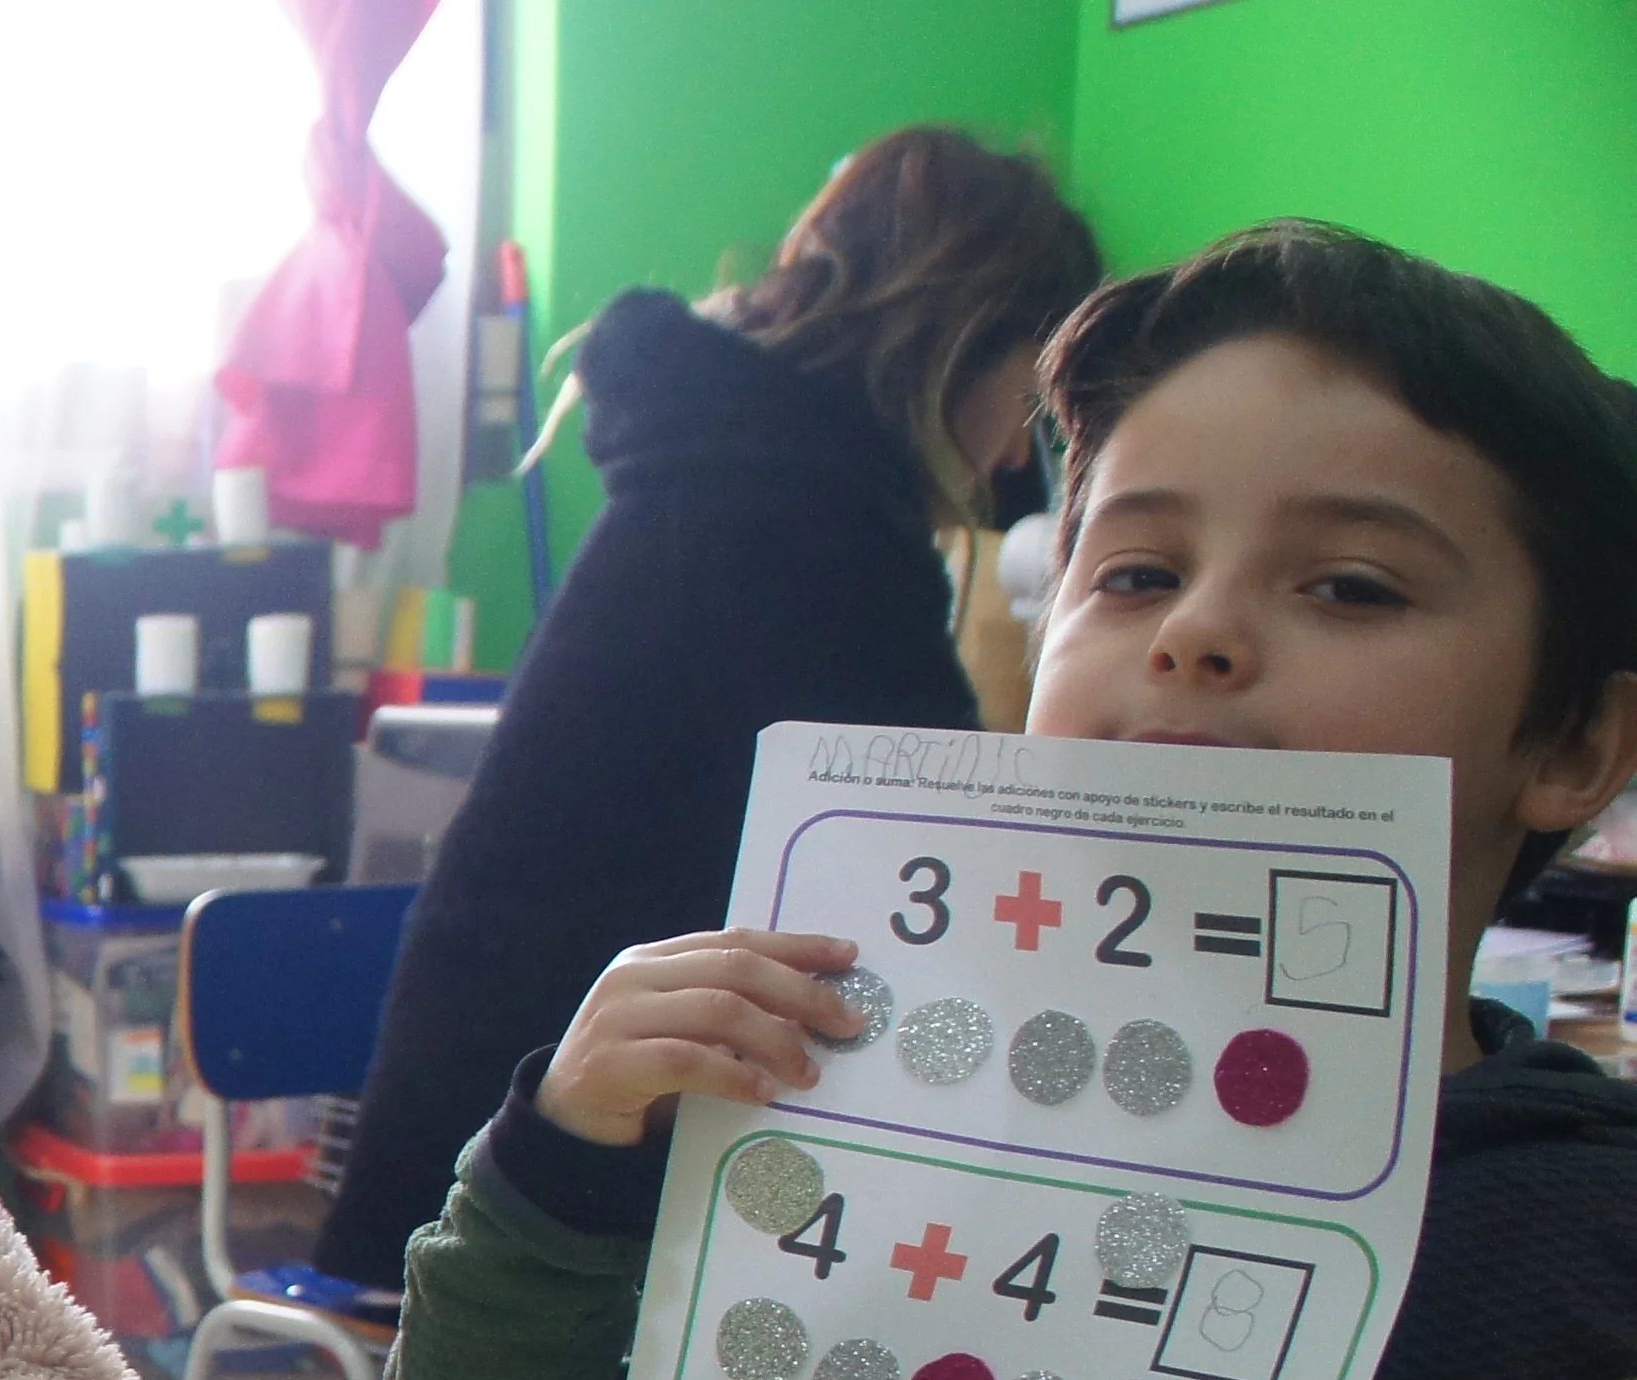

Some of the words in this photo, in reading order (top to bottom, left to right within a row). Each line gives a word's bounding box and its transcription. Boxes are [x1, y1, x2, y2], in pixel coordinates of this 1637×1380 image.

[809, 770, 860, 786] Adición
[863, 777, 871, 786] o
[875, 777, 914, 788] suma:
[917, 777, 974, 792] Resuelve
[977, 782, 994, 794] las
[997, 784, 1055, 798] adiciones
[1058, 790, 1079, 800] con
[1084, 792, 1120, 806] apoyo
[1124, 793, 1140, 805] de
[1143, 794, 1196, 811] stickers
[1200, 802, 1208, 814] y
[1211, 801, 1264, 815] escribe
[1268, 803, 1280, 815] el
[1285, 805, 1354, 820] resultado
[1359, 811, 1377, 820] en
[1381, 810, 1394, 821] el
[991, 802, 1033, 816] cuadro
[1036, 806, 1071, 820] negro
[1075, 809, 1089, 820] de
[1093, 810, 1123, 824] cada
[1127, 814, 1187, 829] ejercicio.
[889, 856, 951, 945] 3
[1095, 875, 1153, 968] 2
[1194, 911, 1262, 957] =
[1280, 896, 1351, 981] 5
[777, 1193, 846, 1280] 4
[992, 1232, 1059, 1322] 4
[1093, 1278, 1168, 1327] =
[1198, 1268, 1264, 1352] 8
